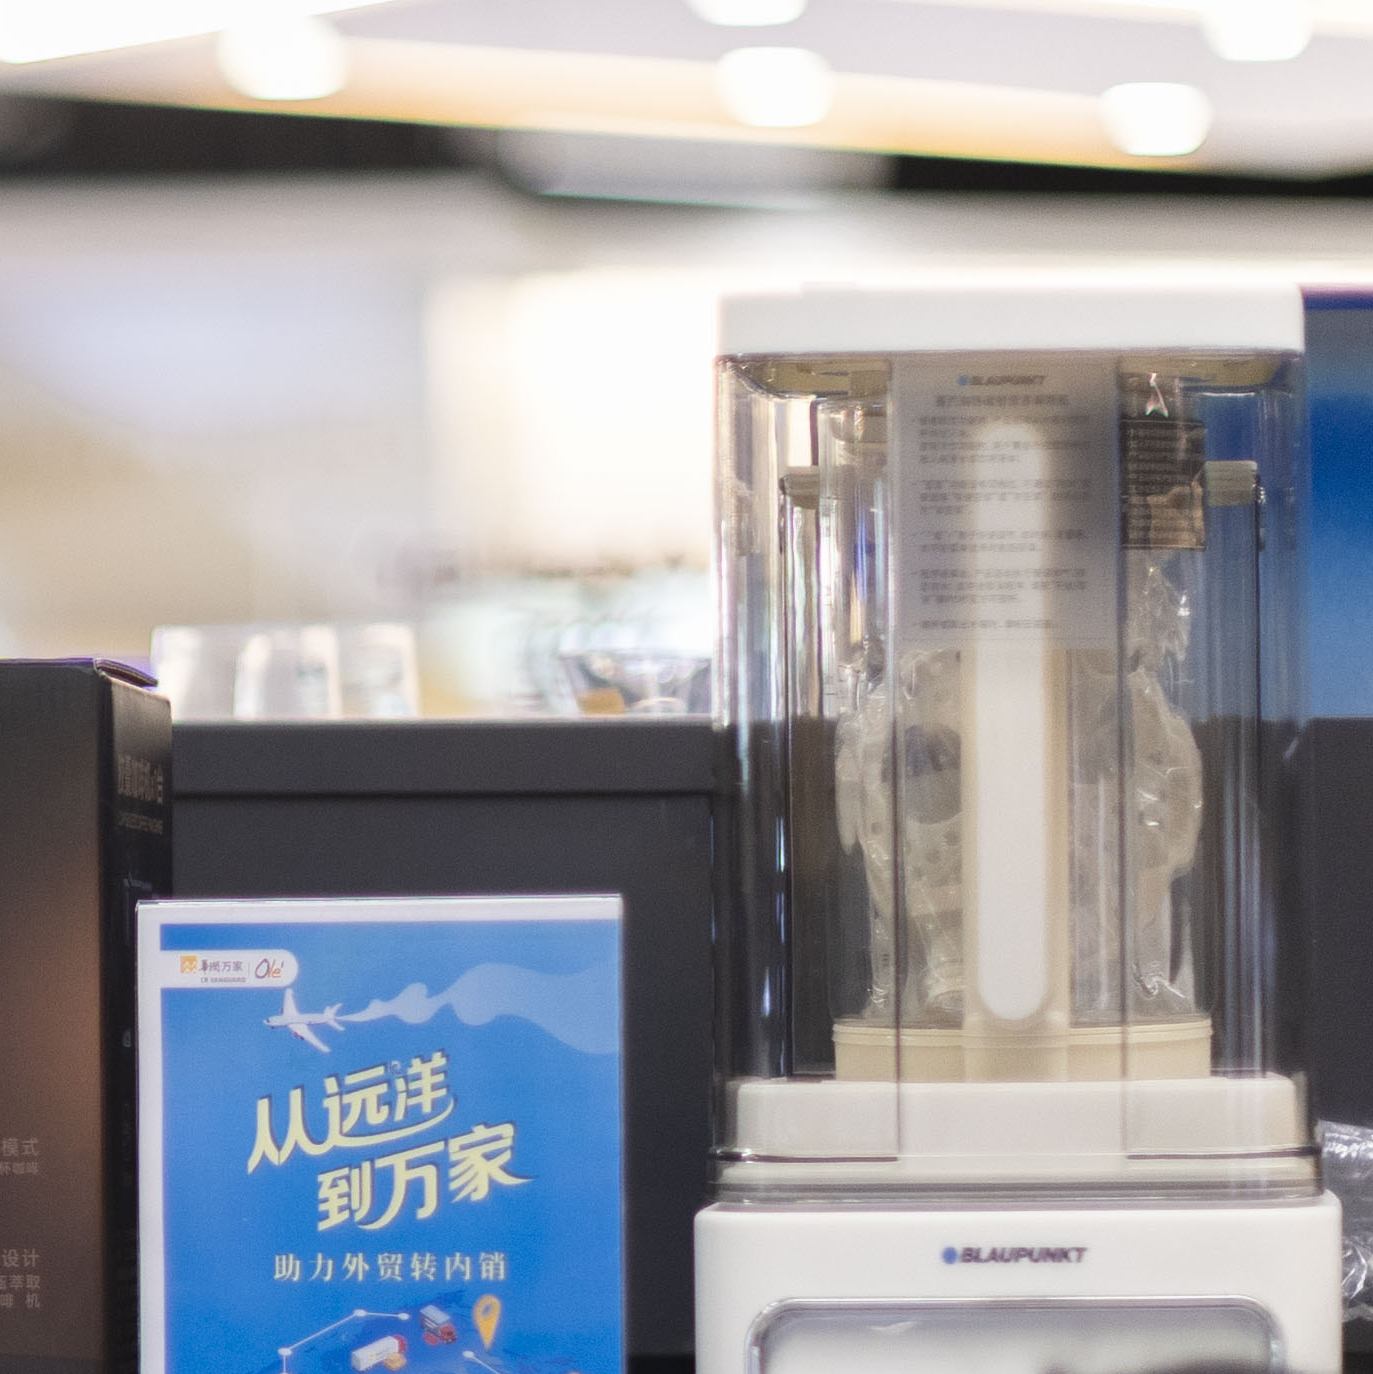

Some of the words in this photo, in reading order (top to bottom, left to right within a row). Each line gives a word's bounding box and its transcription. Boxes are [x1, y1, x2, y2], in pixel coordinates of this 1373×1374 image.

[247, 1049, 457, 1174] 从远洋
[317, 1120, 535, 1232] 到万家
[273, 1251, 508, 1282] 助力外贸转内销
[961, 1246, 1089, 1264] BLAUPUNKT
